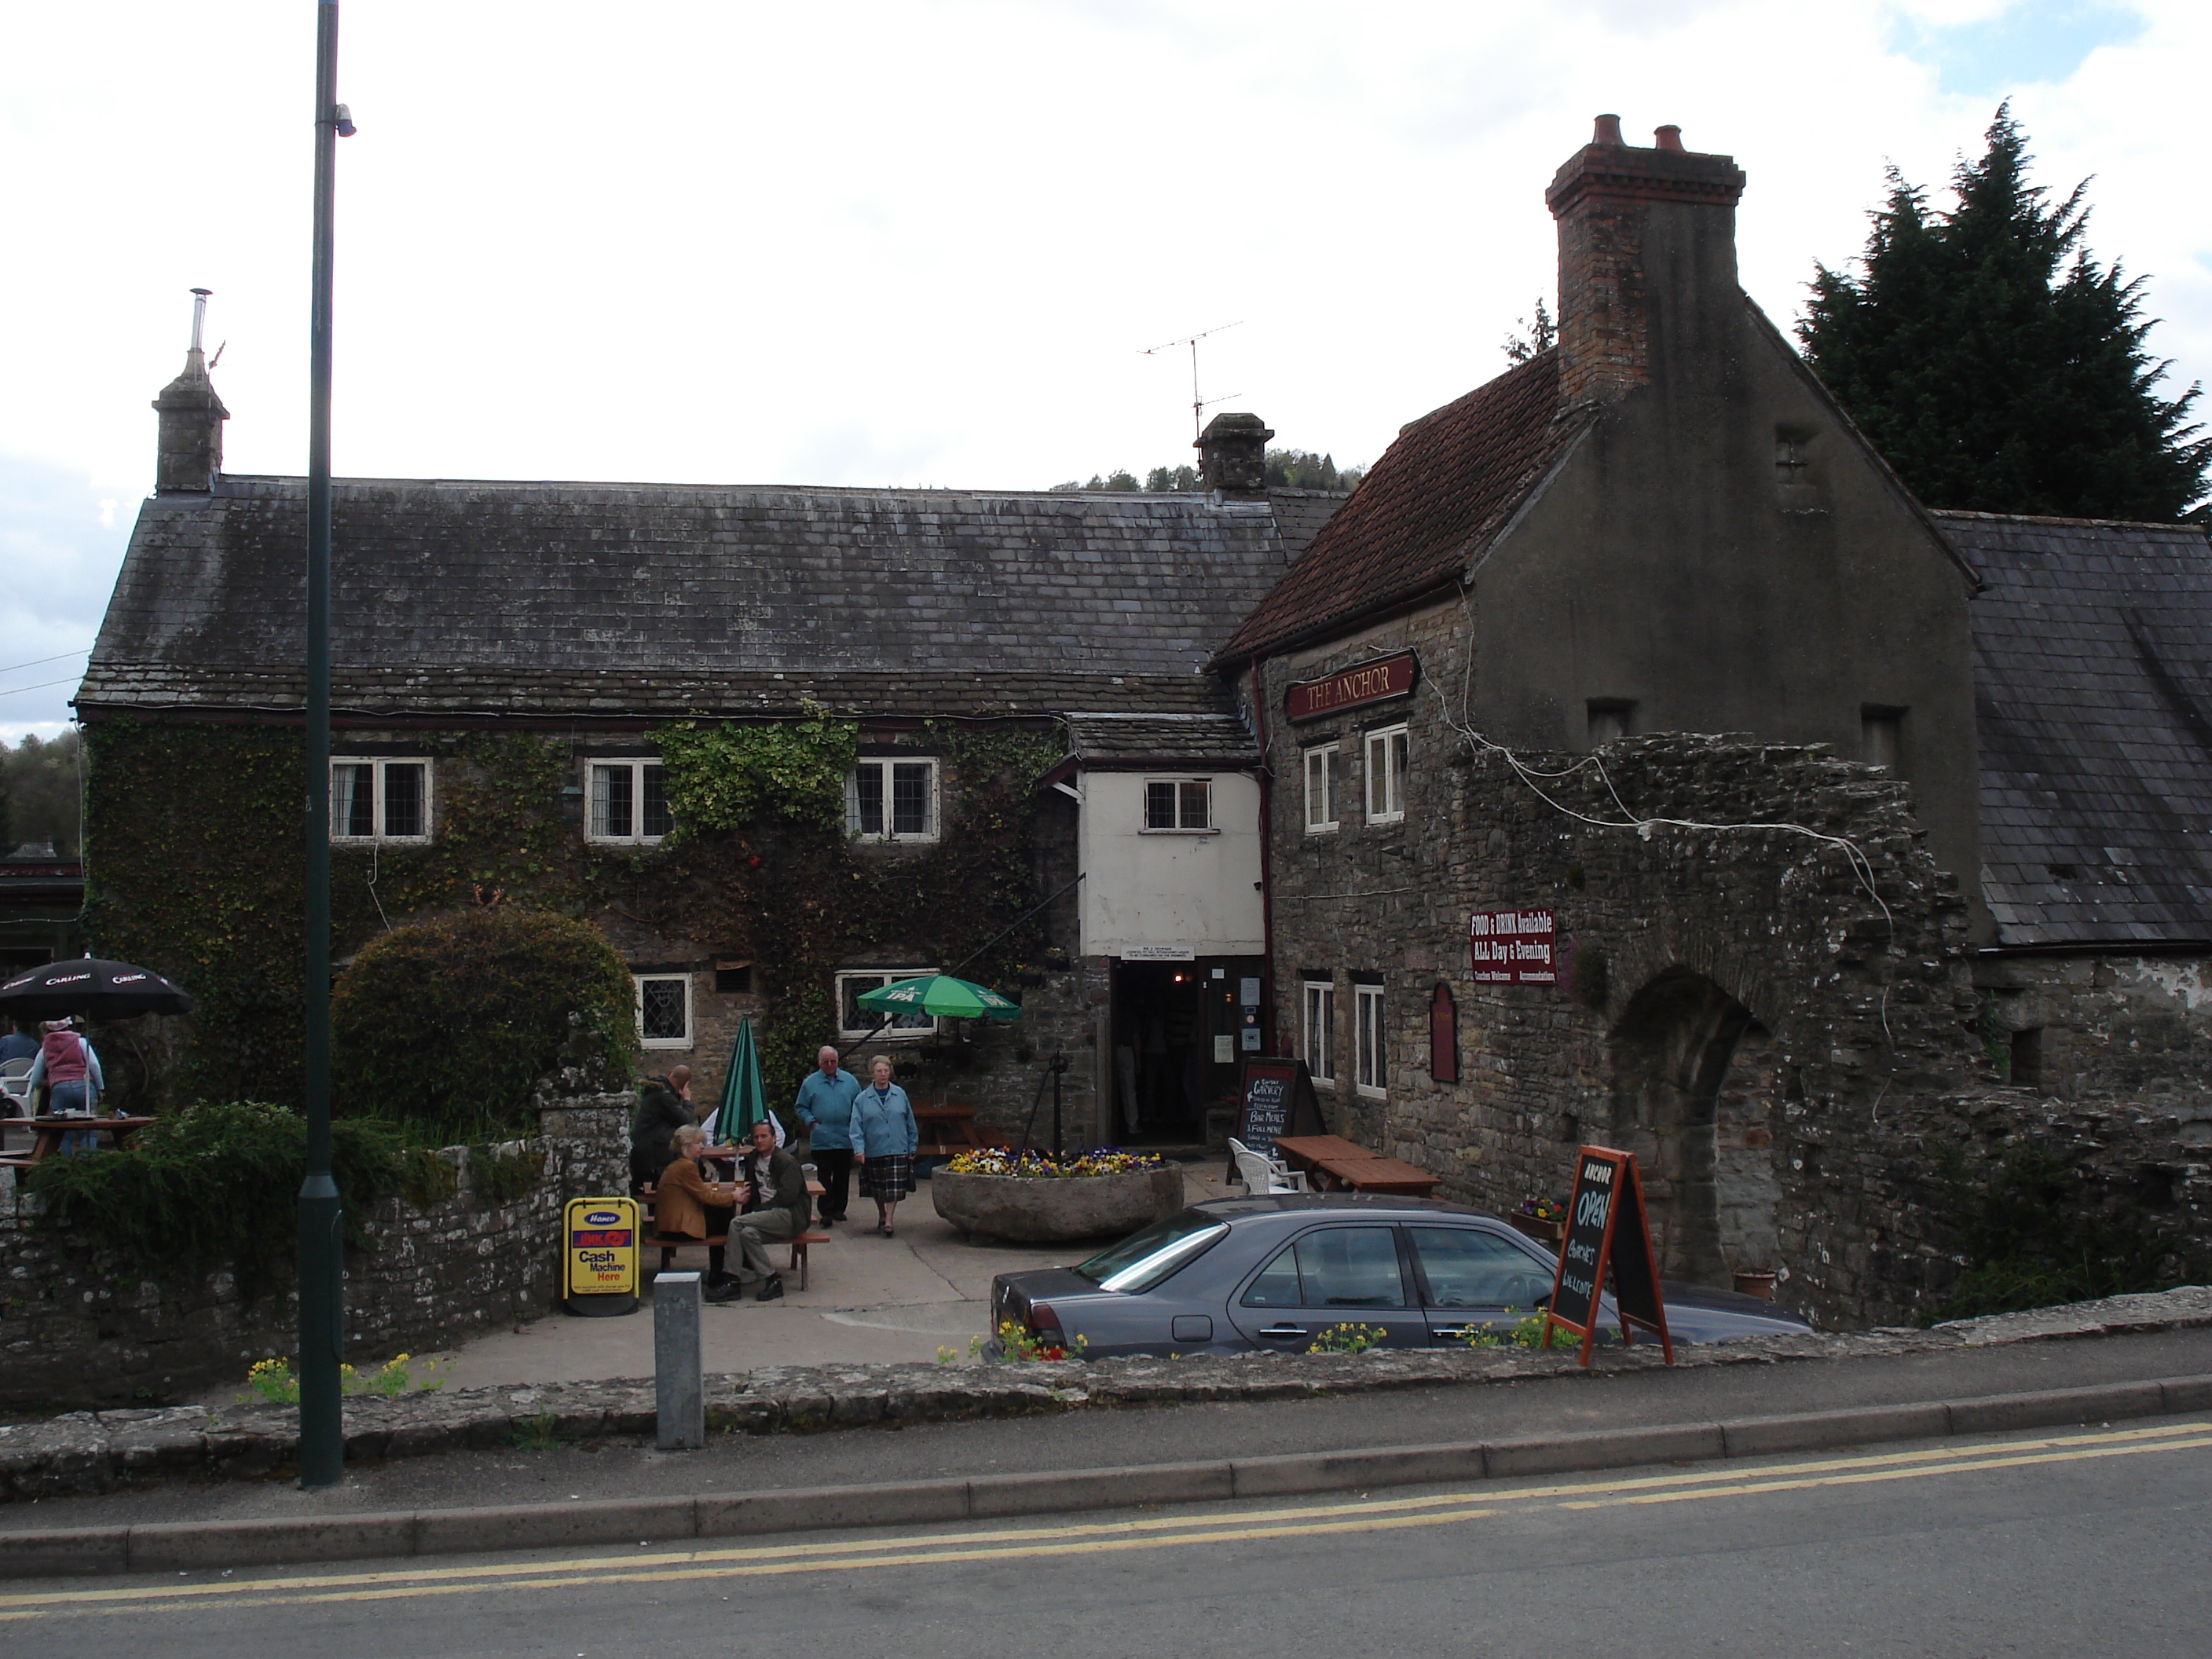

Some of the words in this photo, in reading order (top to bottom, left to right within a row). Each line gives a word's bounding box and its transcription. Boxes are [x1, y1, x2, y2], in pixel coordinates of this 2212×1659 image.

[1307, 682, 1331, 710] THE
[1335, 666, 1390, 703] ANCHOR
[1471, 914, 1489, 936] FOOD
[1490, 917, 1495, 935] &
[1496, 913, 1517, 934] DRINK
[1518, 911, 1552, 934] Available
[1474, 941, 1490, 961] ALL
[1492, 940, 1507, 965] Day
[1509, 943, 1514, 960] &
[1515, 939, 1551, 965] Evening
[45, 972, 92, 987] CARLING
[112, 972, 147, 985] CARLING
[885, 992, 916, 1002] IPA
[1584, 1163, 1613, 1185] ANCHOR
[1577, 1190, 1612, 1231] OPEN
[590, 1214, 616, 1223] Hanco
[579, 1251, 615, 1262] Cash
[590, 1263, 625, 1272] Machine
[598, 1273, 621, 1281] Here
[1562, 1269, 1593, 1301] WELCOME
